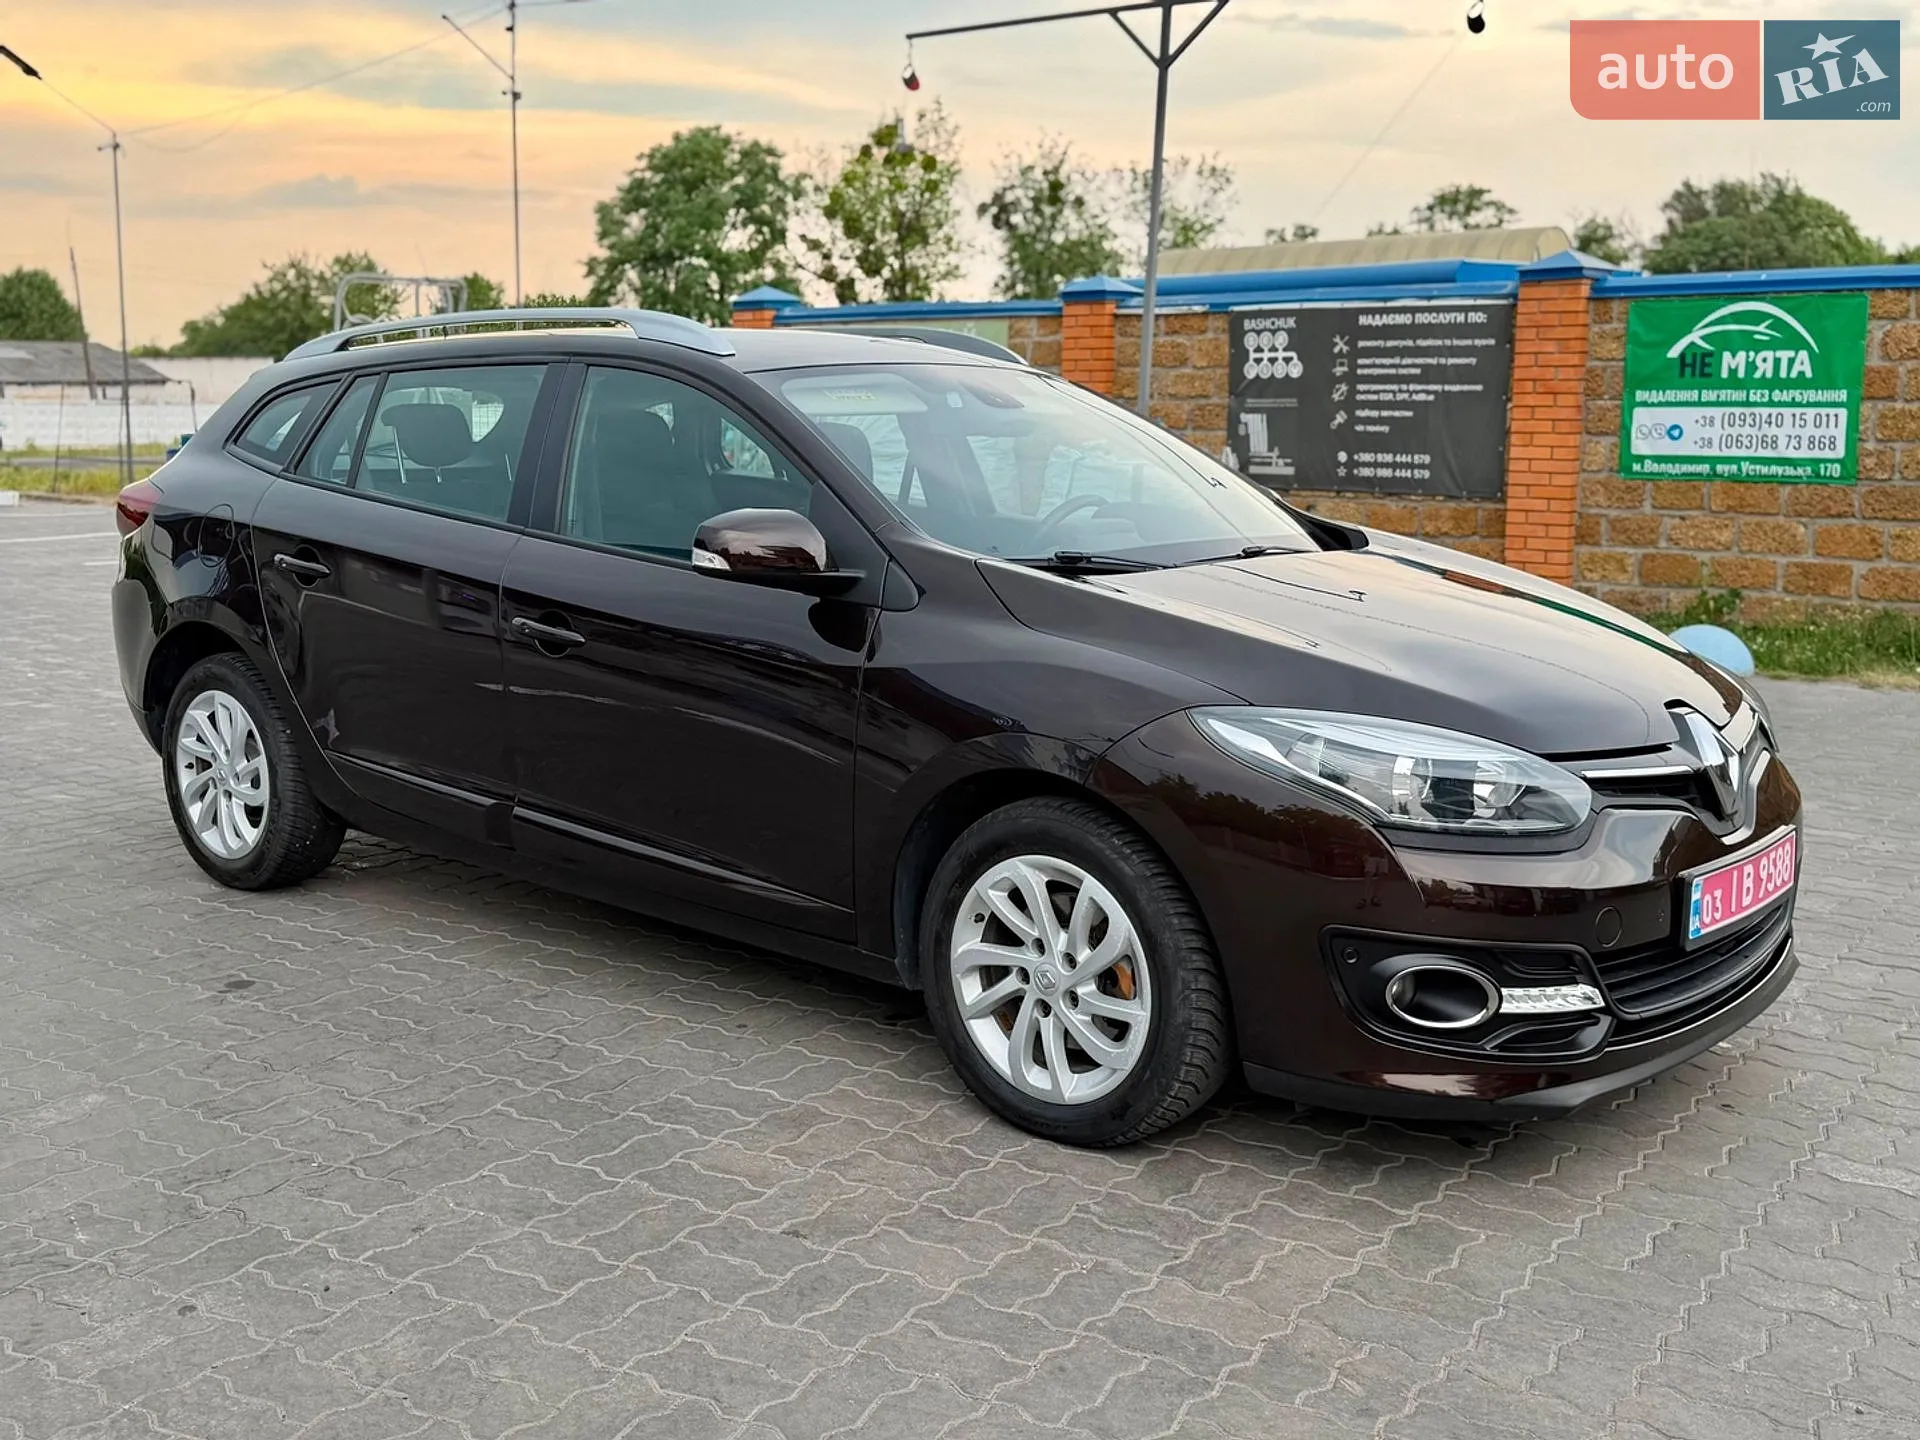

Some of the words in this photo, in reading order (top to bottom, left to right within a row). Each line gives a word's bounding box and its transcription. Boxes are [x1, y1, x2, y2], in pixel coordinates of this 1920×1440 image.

[1358, 312, 1413, 327] НАДАЄМО
[1414, 312, 1465, 325] ПОСЛУГИ
[1467, 311, 1488, 324] ПО:
[1678, 351, 1714, 378] НЕ
[1635, 389, 1698, 404] ВИДАЛЕННЯ
[1749, 389, 1769, 402] БЕЗ
[1772, 388, 1847, 403] ФАРБУВАННЯ
[1694, 415, 1715, 428] +38
[1791, 412, 1808, 428] 15
[1813, 412, 1840, 429] 011
[1693, 437, 1713, 449] +38
[1785, 435, 1802, 451] 73
[1807, 435, 1837, 451] 868
[1395, 453, 1412, 463] 444
[1394, 468, 1412, 478] 444
[1819, 463, 1841, 477] 170
[1703, 888, 1722, 924] 03
[1758, 842, 1791, 898] 9588
